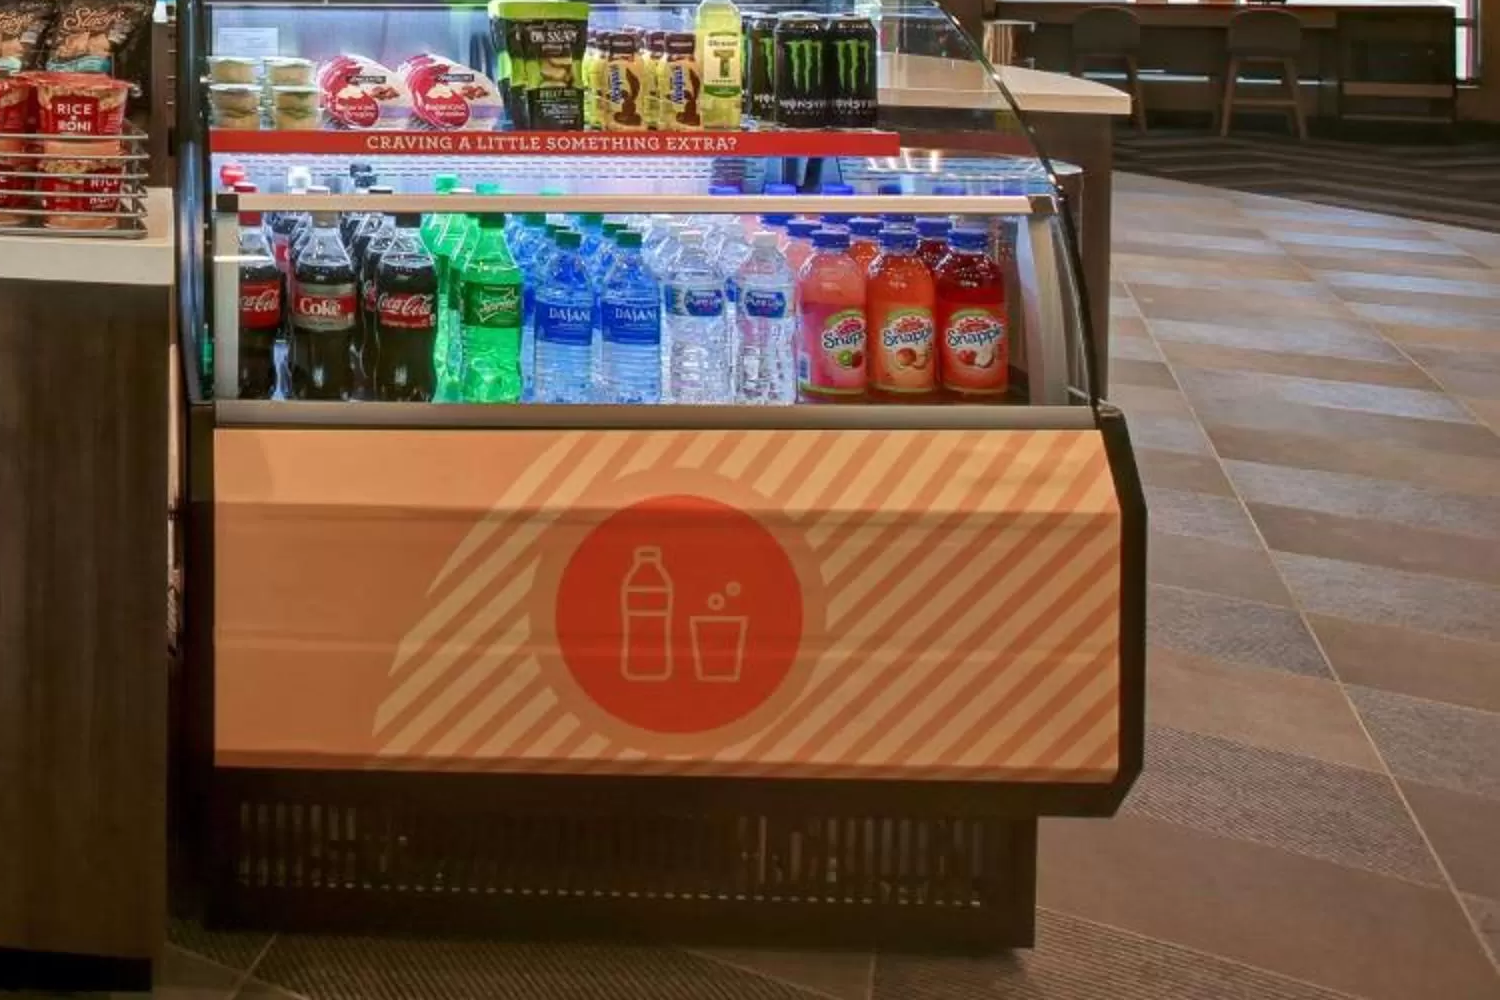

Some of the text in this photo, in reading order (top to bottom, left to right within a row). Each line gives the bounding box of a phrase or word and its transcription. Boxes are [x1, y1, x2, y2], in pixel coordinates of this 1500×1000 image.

[57, 103, 93, 115] RICE
[57, 120, 92, 132] RONI
[366, 135, 738, 151] CRAVING A LITTLE SOMETHING EXTRA?
[299, 298, 342, 316] Coke
[377, 292, 435, 316] Coca-Cola
